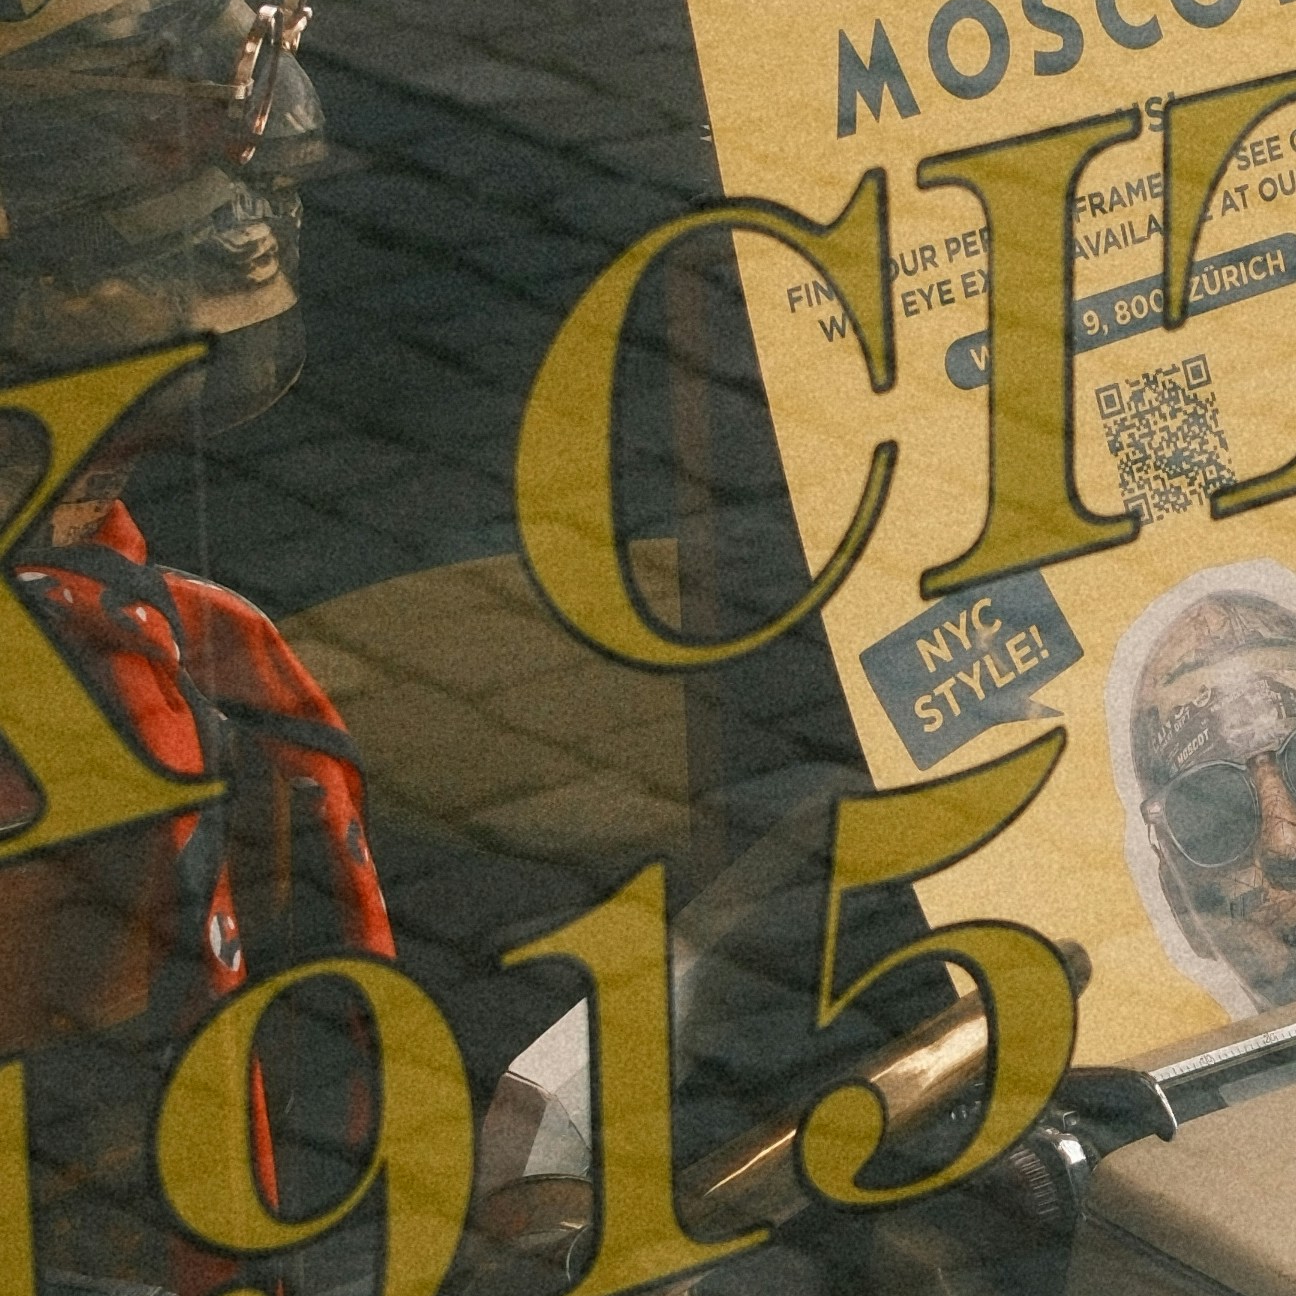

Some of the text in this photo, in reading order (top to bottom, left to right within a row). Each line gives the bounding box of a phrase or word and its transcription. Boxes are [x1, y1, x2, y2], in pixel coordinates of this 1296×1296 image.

[1234, 135, 1284, 171] SEE
[901, 279, 956, 318] EYE
[1220, 184, 1249, 217] AT
[1188, 248, 1286, 303] ZÜRICH
[915, 597, 1003, 672] NYC
[913, 624, 1052, 733] STYLE!
